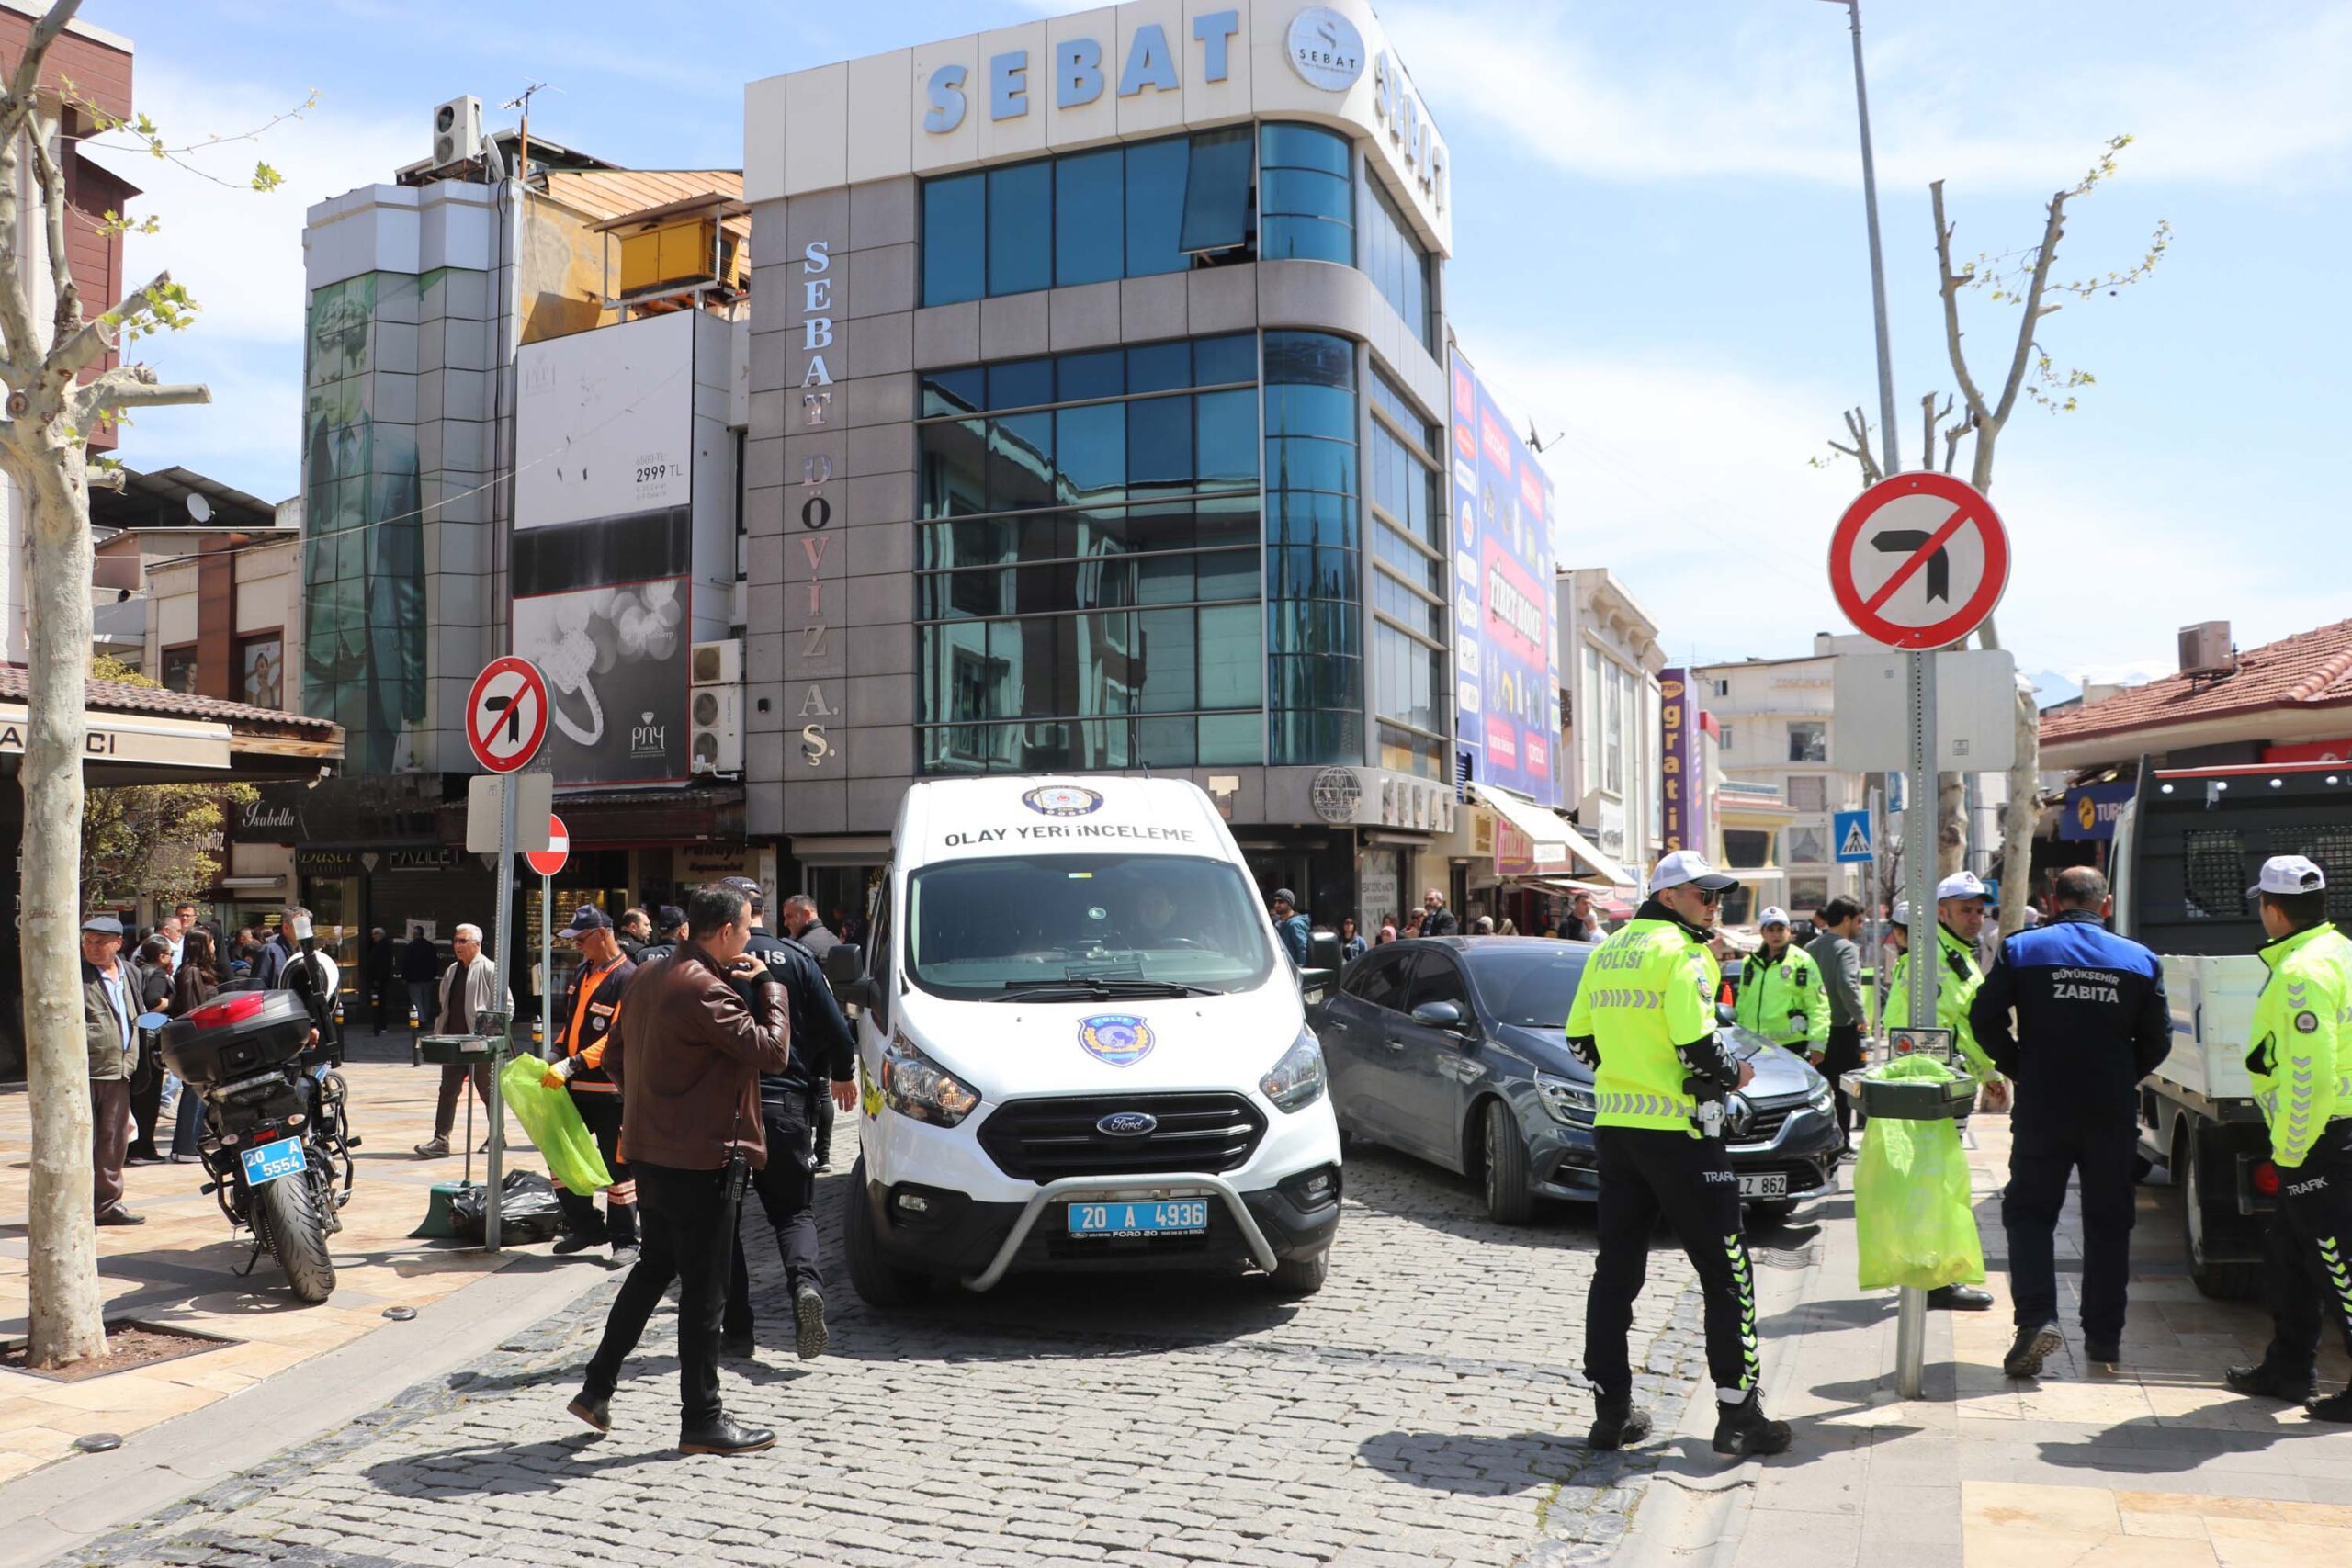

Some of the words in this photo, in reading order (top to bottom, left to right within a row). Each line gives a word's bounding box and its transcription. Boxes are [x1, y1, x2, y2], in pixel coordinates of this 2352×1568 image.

[1299, 49, 1356, 69] SEBAT
[924, 10, 1239, 134] SEBAT
[801, 241, 833, 426] SEBAT
[636, 464, 666, 483] 2999
[669, 463, 683, 477] TL
[801, 455, 833, 658] DÖVİZ
[1662, 705, 1681, 853] gratis
[243, 800, 295, 828] Isabella
[944, 829, 1008, 847] OLAY
[2052, 968, 2120, 986] BÜYÜKŞEHİR
[2053, 983, 2120, 1003] ZABITA
[1111, 1116, 1143, 1131] Ford
[243, 1149, 266, 1168] 20
[288, 1141, 300, 1155] A
[262, 1158, 300, 1178] 5554
[1761, 1177, 1785, 1194] 862
[1082, 1206, 1107, 1229] 20
[1125, 1205, 1136, 1228] A
[1155, 1203, 1204, 1227] 4936
[1143, 1229, 1158, 1237] 20
